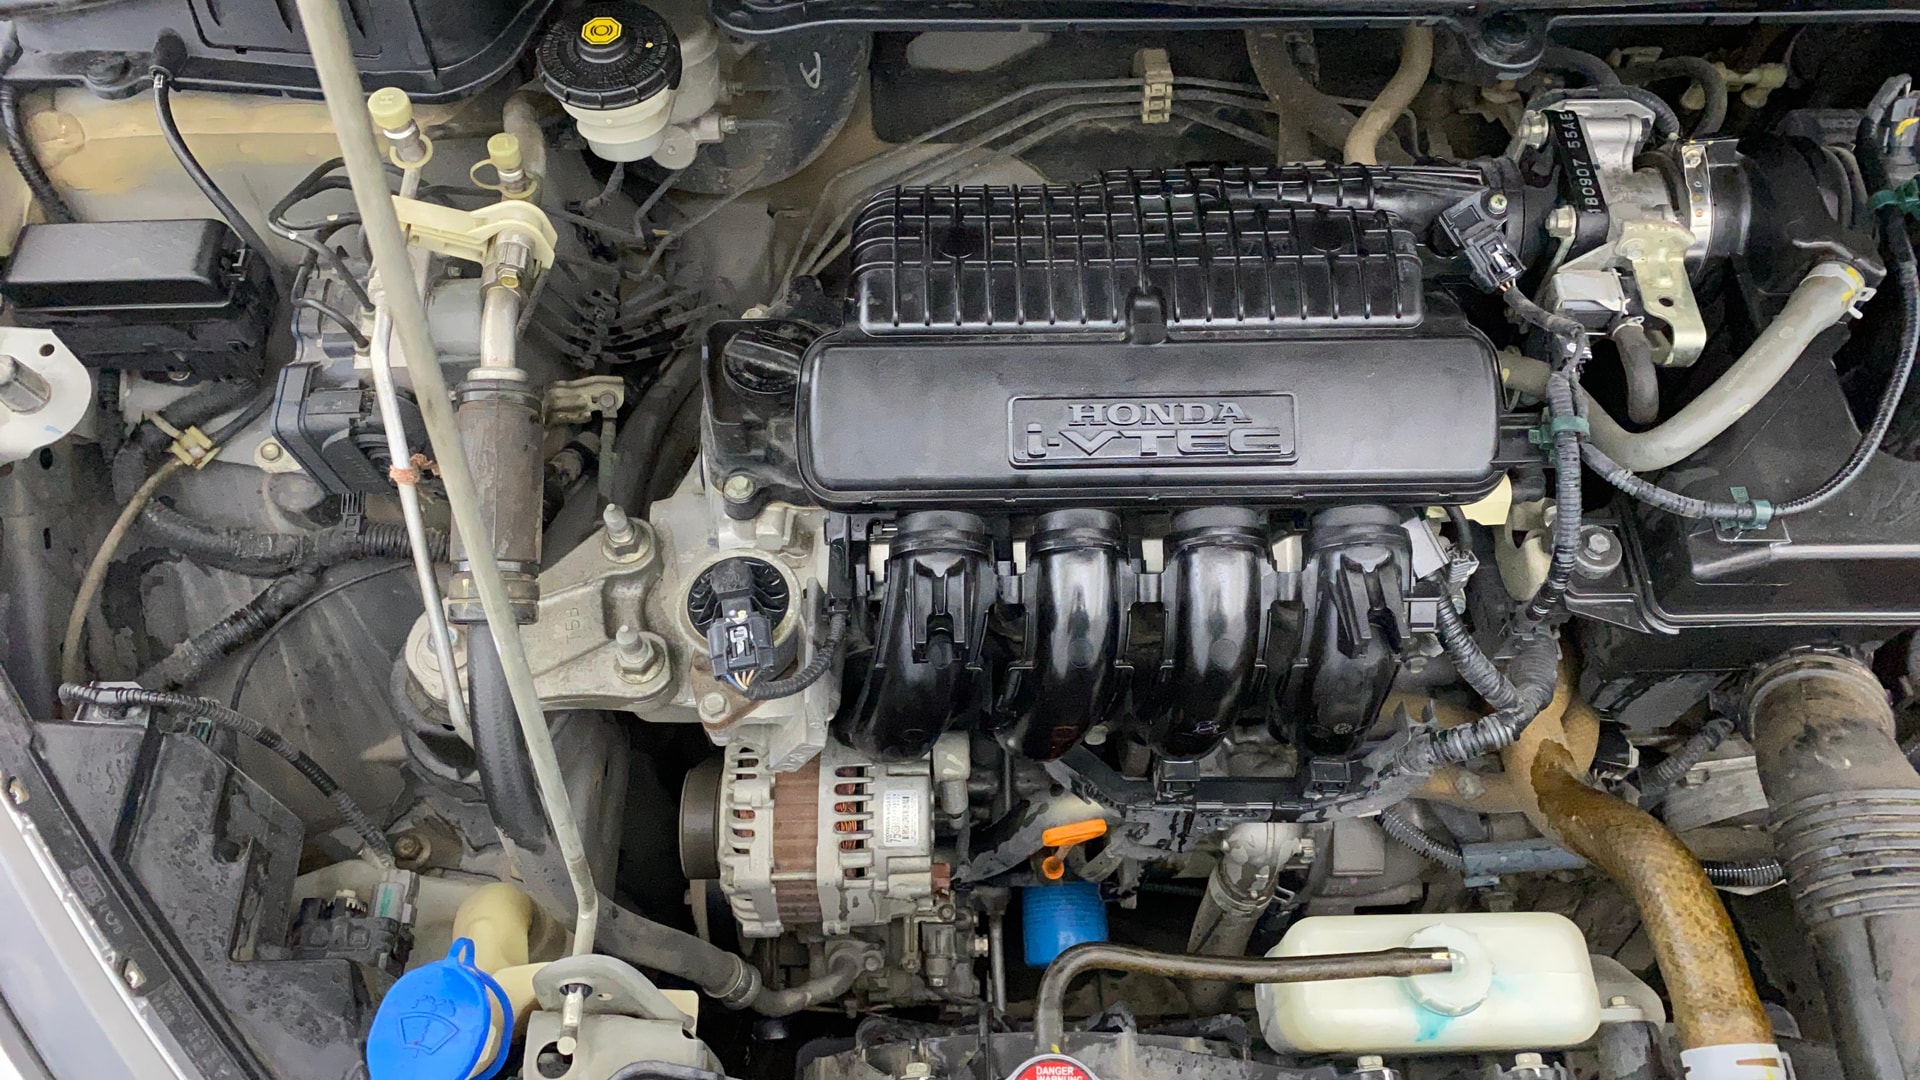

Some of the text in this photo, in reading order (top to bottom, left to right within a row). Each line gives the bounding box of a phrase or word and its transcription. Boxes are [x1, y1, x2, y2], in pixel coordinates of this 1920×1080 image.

[1572, 158, 1602, 214] 180907
[1068, 402, 1252, 426] HONDA
[1027, 423, 1281, 456] i-VTEC
[1036, 1066, 1074, 1076] DANGER
